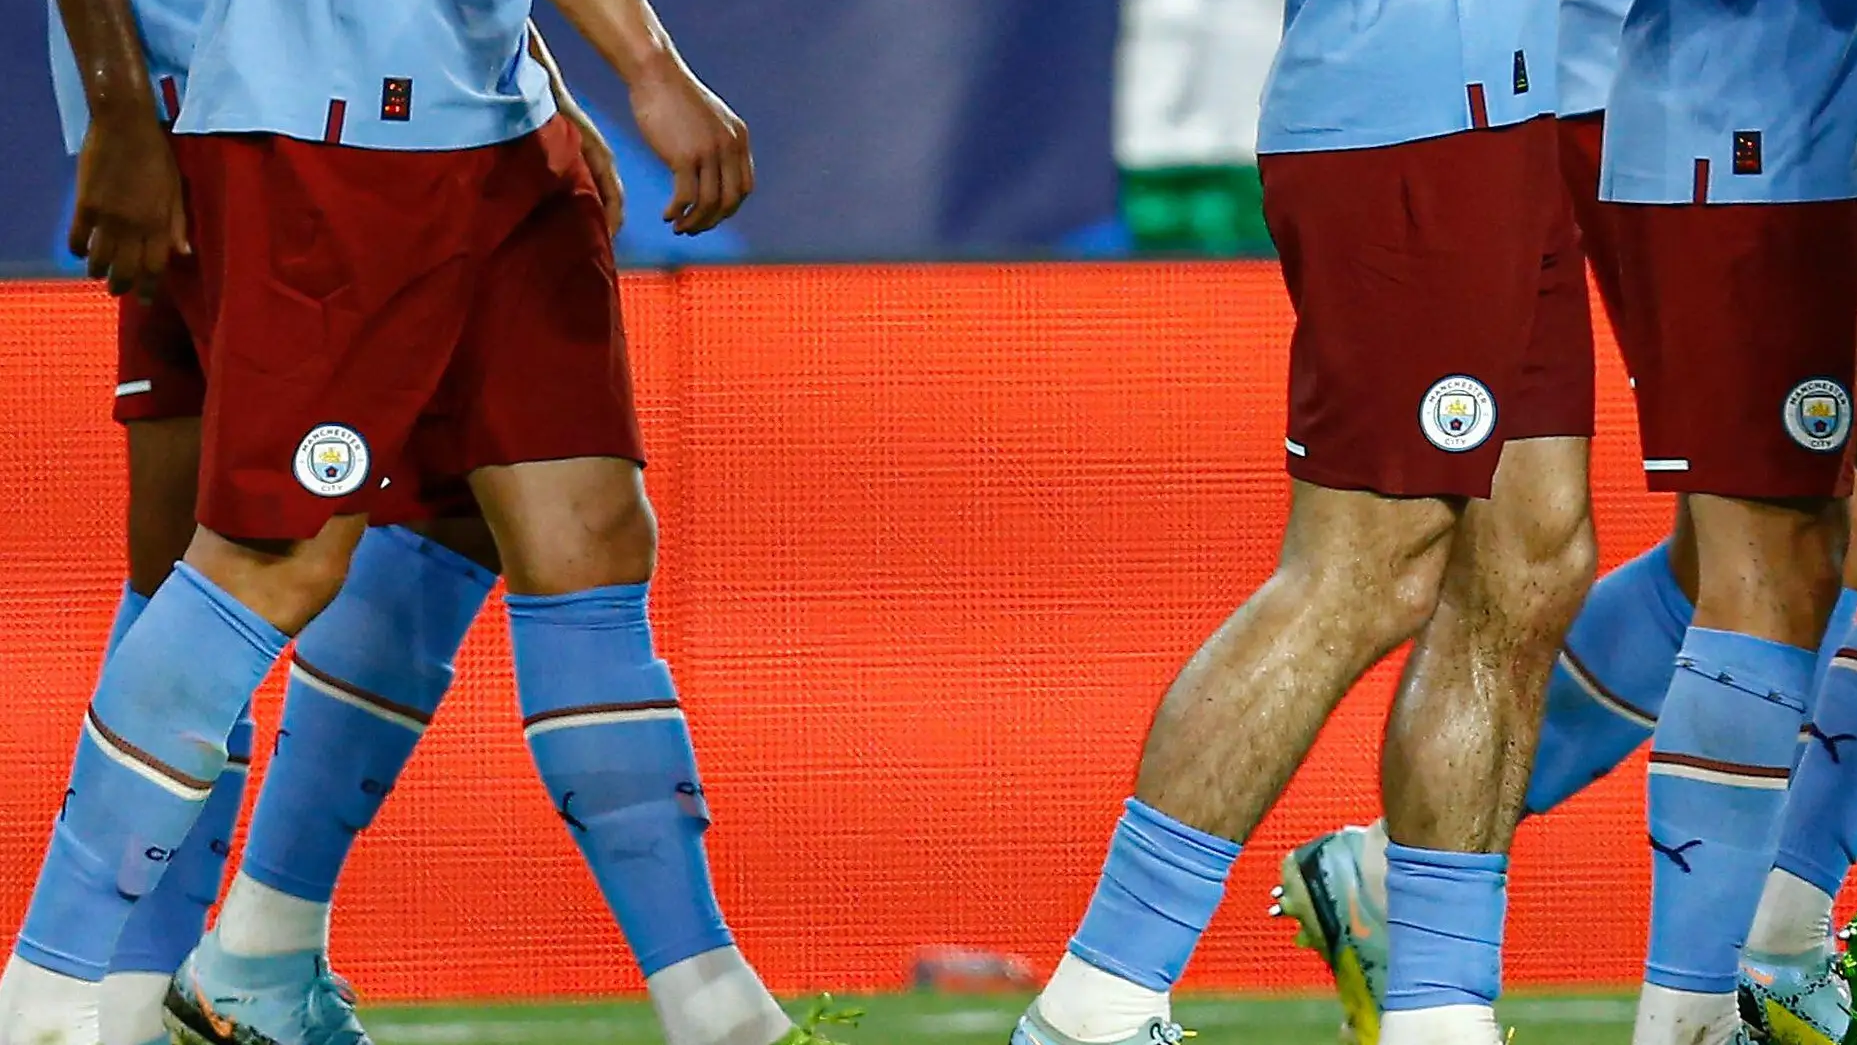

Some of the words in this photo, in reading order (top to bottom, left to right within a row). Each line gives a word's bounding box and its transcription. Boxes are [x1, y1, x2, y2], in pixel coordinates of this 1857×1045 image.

[1428, 381, 1487, 404] MANCHESTER
[302, 429, 361, 452] MANCHESTER
[321, 484, 343, 492] CITY
